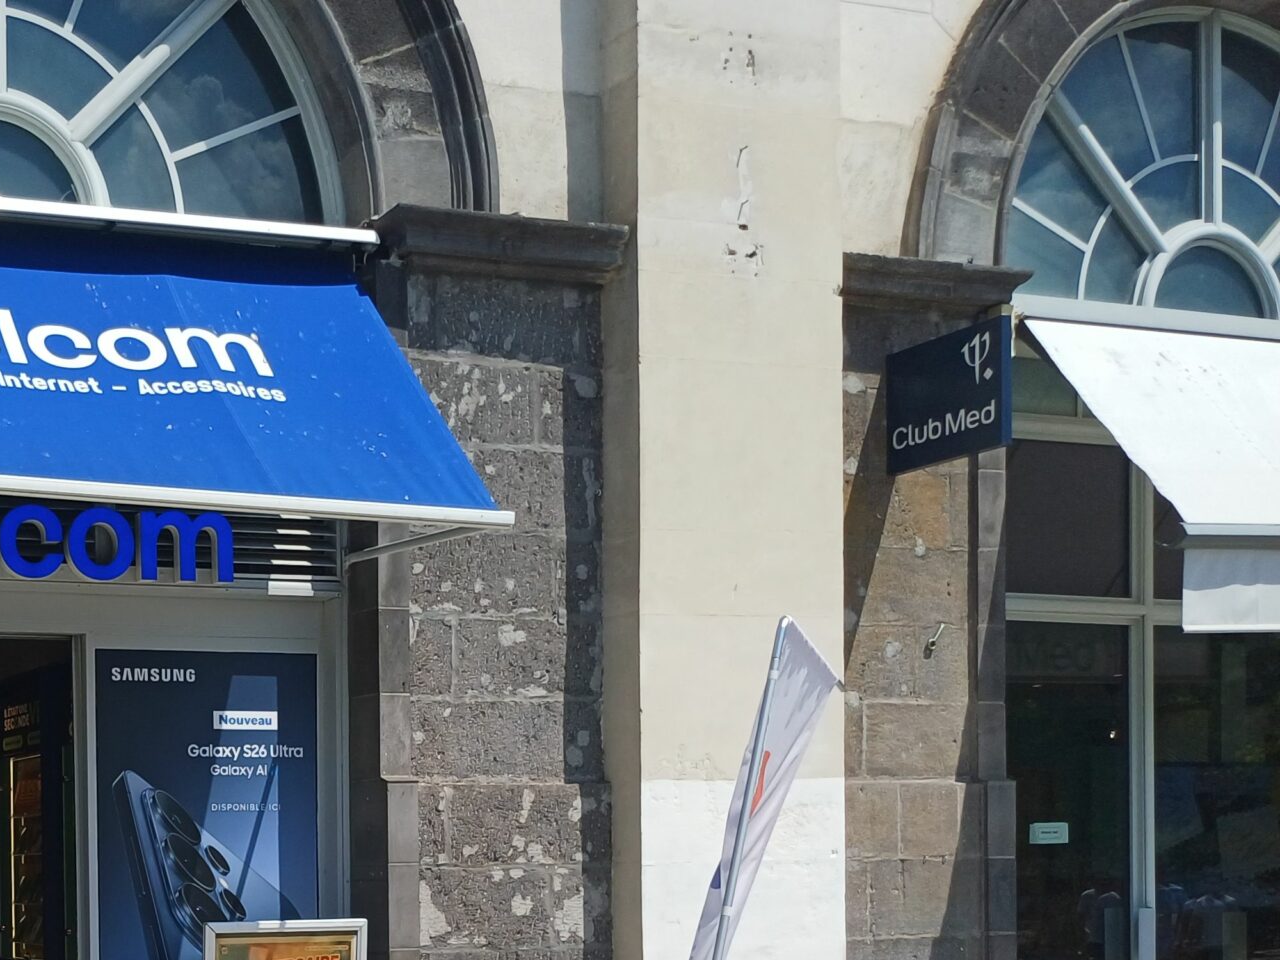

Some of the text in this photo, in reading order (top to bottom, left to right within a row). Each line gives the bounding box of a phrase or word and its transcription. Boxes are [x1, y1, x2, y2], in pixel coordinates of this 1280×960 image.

[137, 378, 287, 402] Accessoires
[892, 399, 996, 450] Club Med
[111, 667, 196, 682] SAMSUNG
[219, 714, 272, 726] Nouveau
[187, 744, 304, 761] Galaxy S26 Ultra
[210, 765, 268, 779] Galaxy AI
[211, 803, 266, 812] DISPONIBLE
